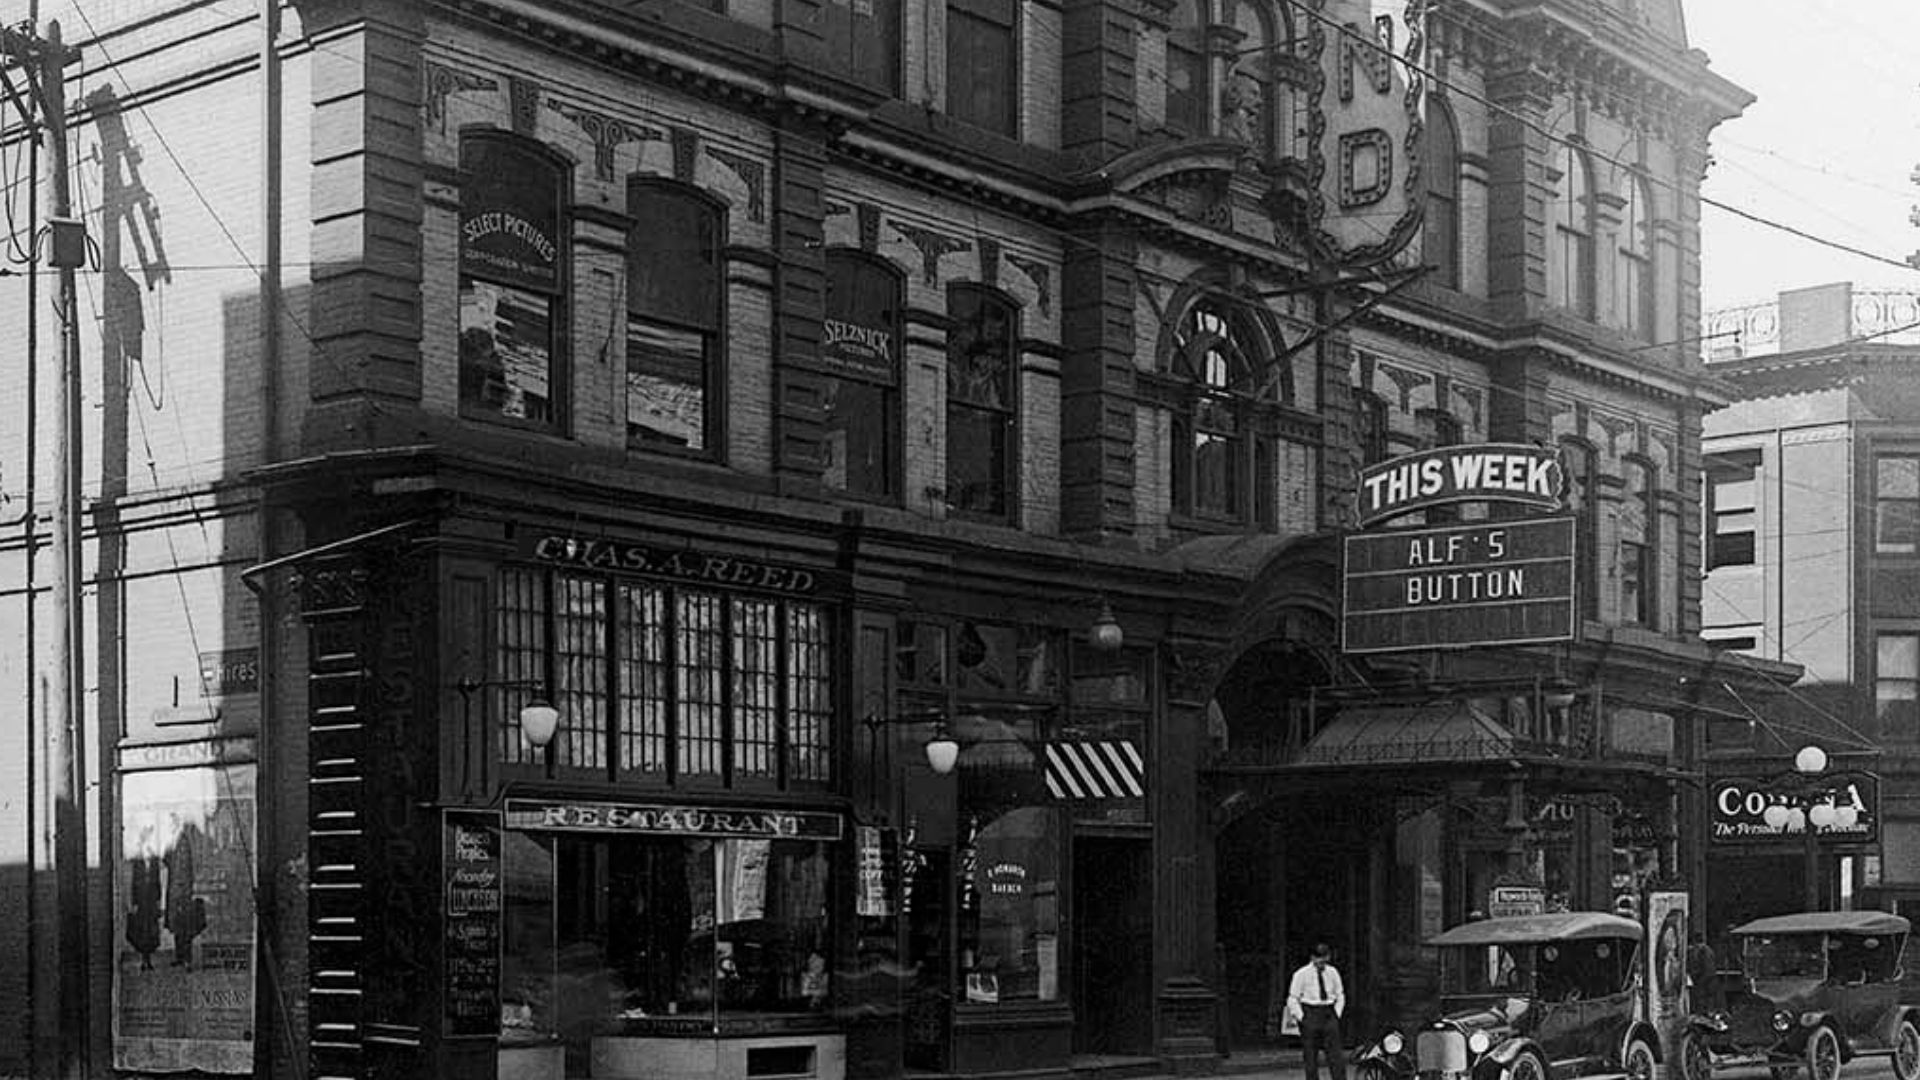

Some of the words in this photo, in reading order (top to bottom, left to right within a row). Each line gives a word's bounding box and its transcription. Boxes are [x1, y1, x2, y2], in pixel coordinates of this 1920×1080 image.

[462, 212, 502, 242] SELECT
[504, 212, 556, 262] PICTURES
[824, 318, 890, 361] SELZNICK
[1364, 459, 1443, 510] THIS
[1451, 455, 1553, 496] WEEK
[703, 557, 814, 591] REED
[1407, 569, 1523, 604] BUTTON
[542, 806, 805, 835] RESTAURANT
